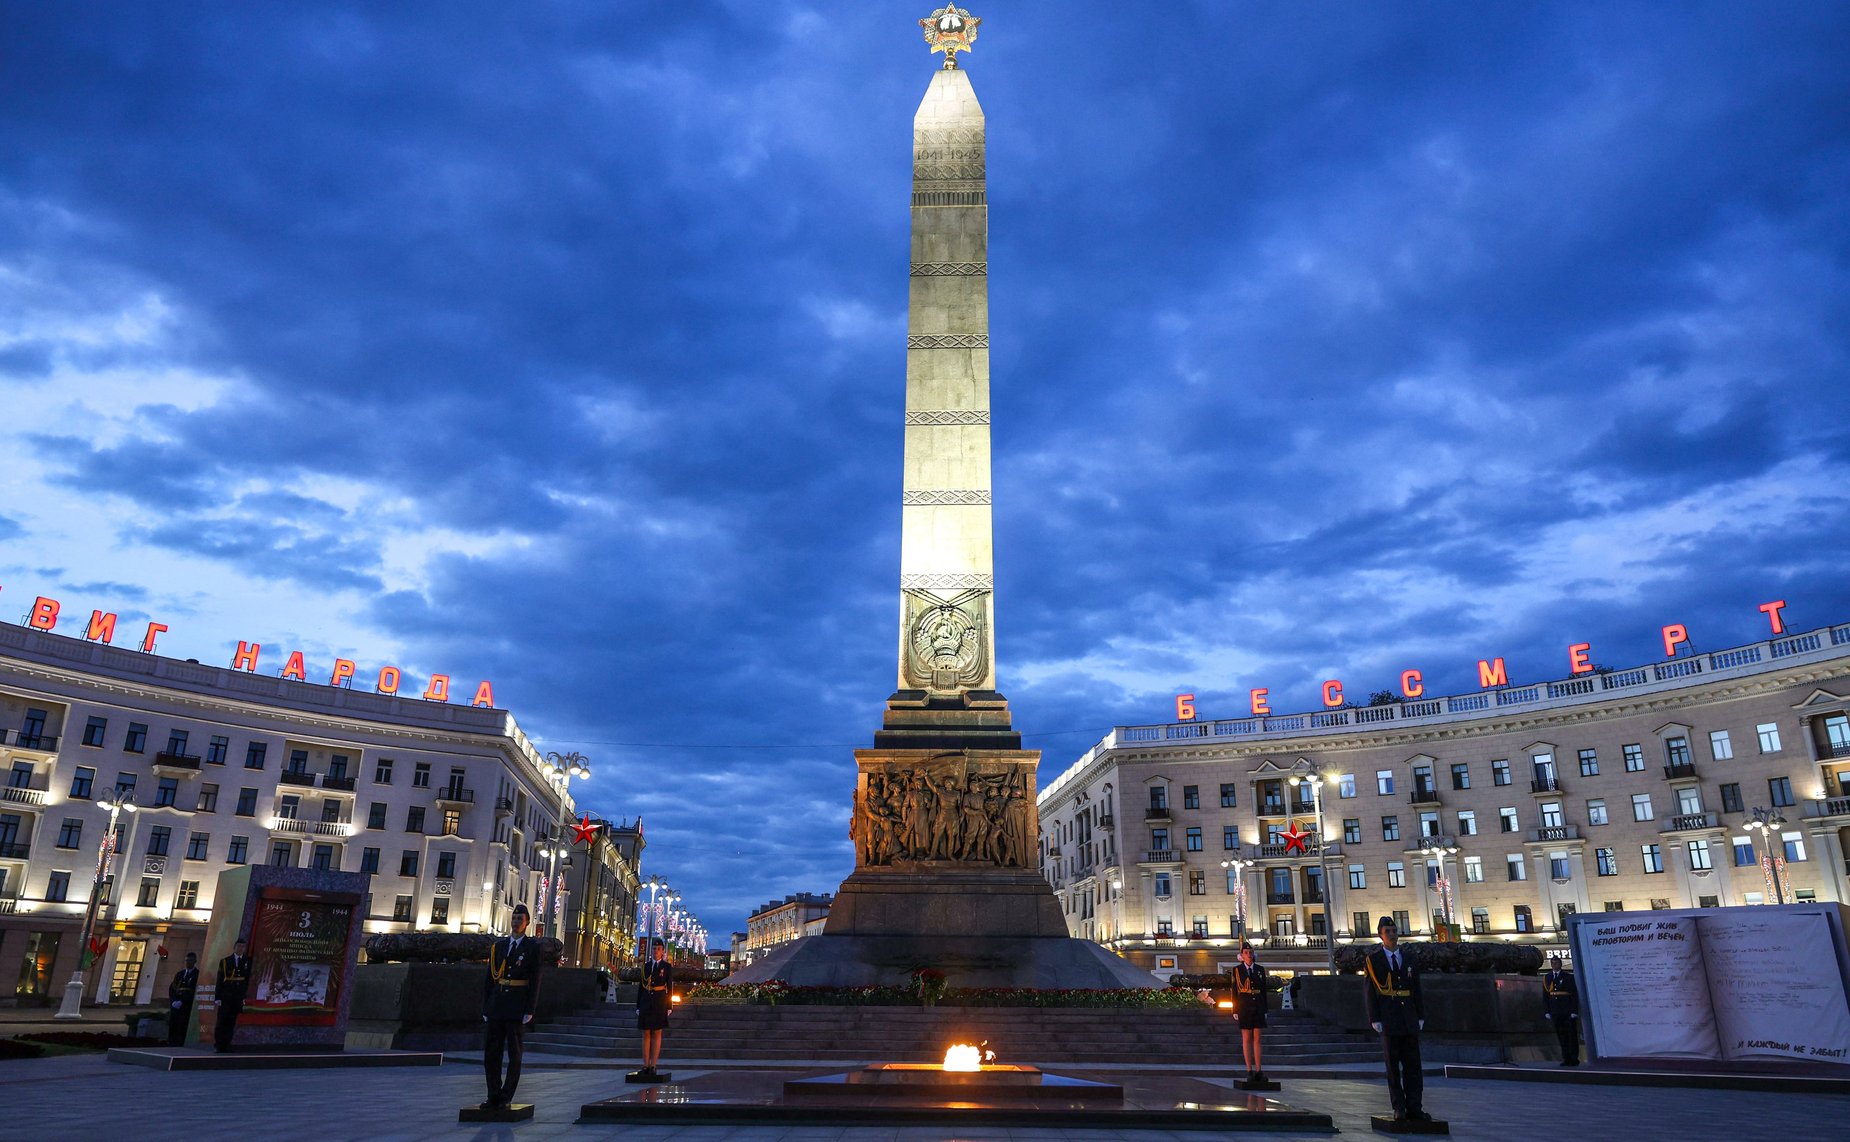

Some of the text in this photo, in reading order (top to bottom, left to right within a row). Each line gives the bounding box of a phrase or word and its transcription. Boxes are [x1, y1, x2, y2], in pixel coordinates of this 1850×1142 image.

[0, 586, 494, 708] ВИГ НАРОДА
[1176, 600, 1787, 720] БЕССМЕРТ
[298, 911, 312, 929] 3
[1619, 922, 1652, 934] ПОДВИГ
[1592, 934, 1645, 946] НЕПОВТОРИМ
